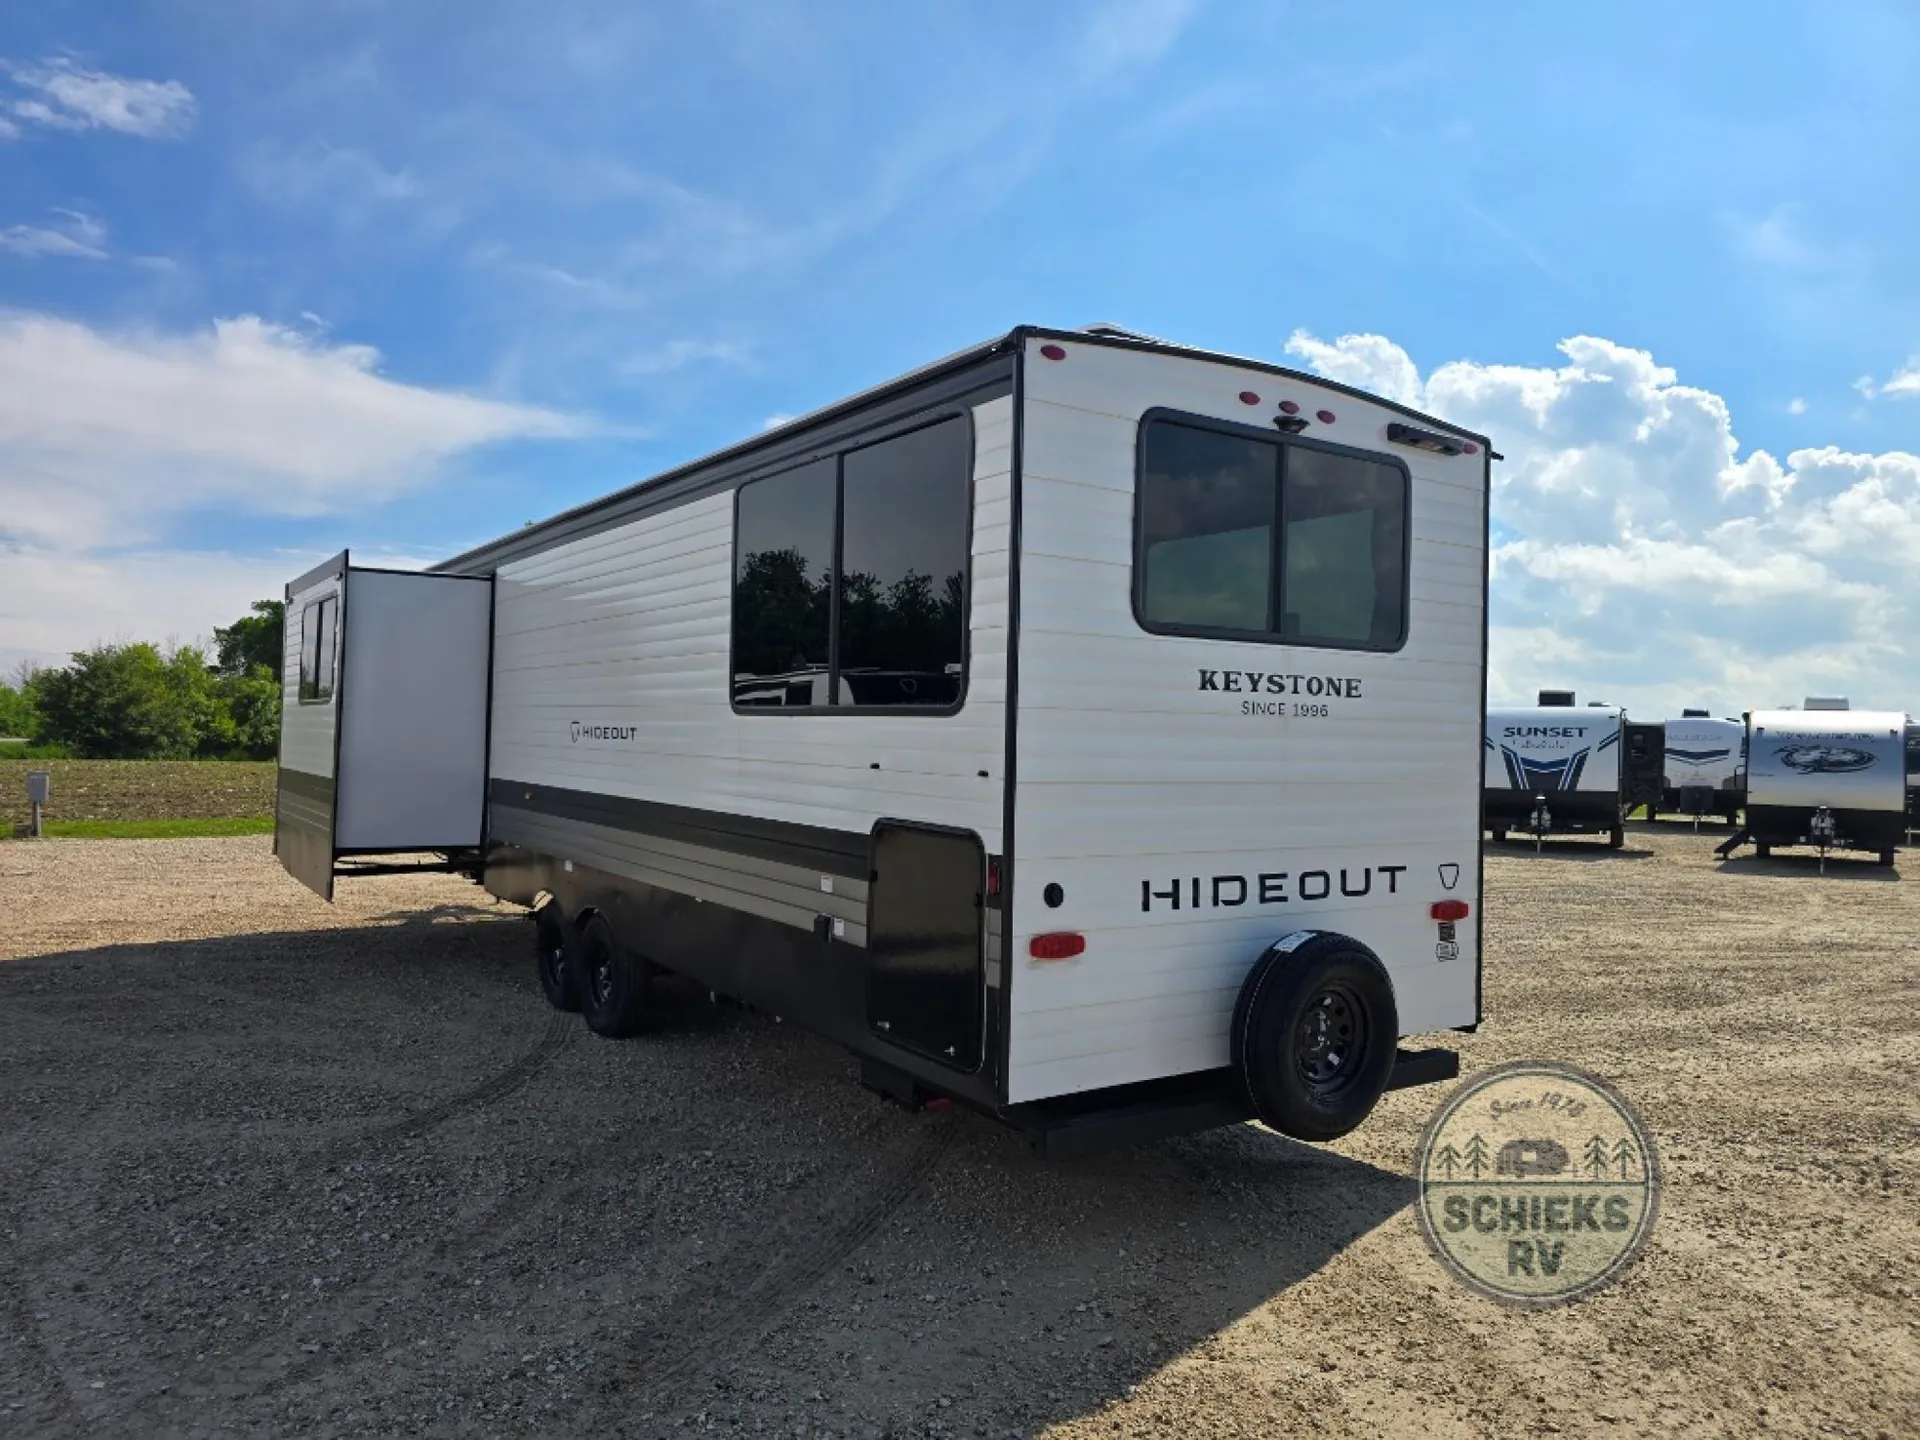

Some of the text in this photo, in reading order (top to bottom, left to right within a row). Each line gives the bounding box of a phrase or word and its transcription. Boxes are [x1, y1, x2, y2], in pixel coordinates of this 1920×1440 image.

[1198, 669, 1362, 698] KEYSTONE
[1241, 700, 1329, 717] SINCE 1996
[582, 726, 638, 741] HIDEOUT
[1503, 727, 1589, 738] SUNSET
[1141, 865, 1408, 912] HIDEOUT
